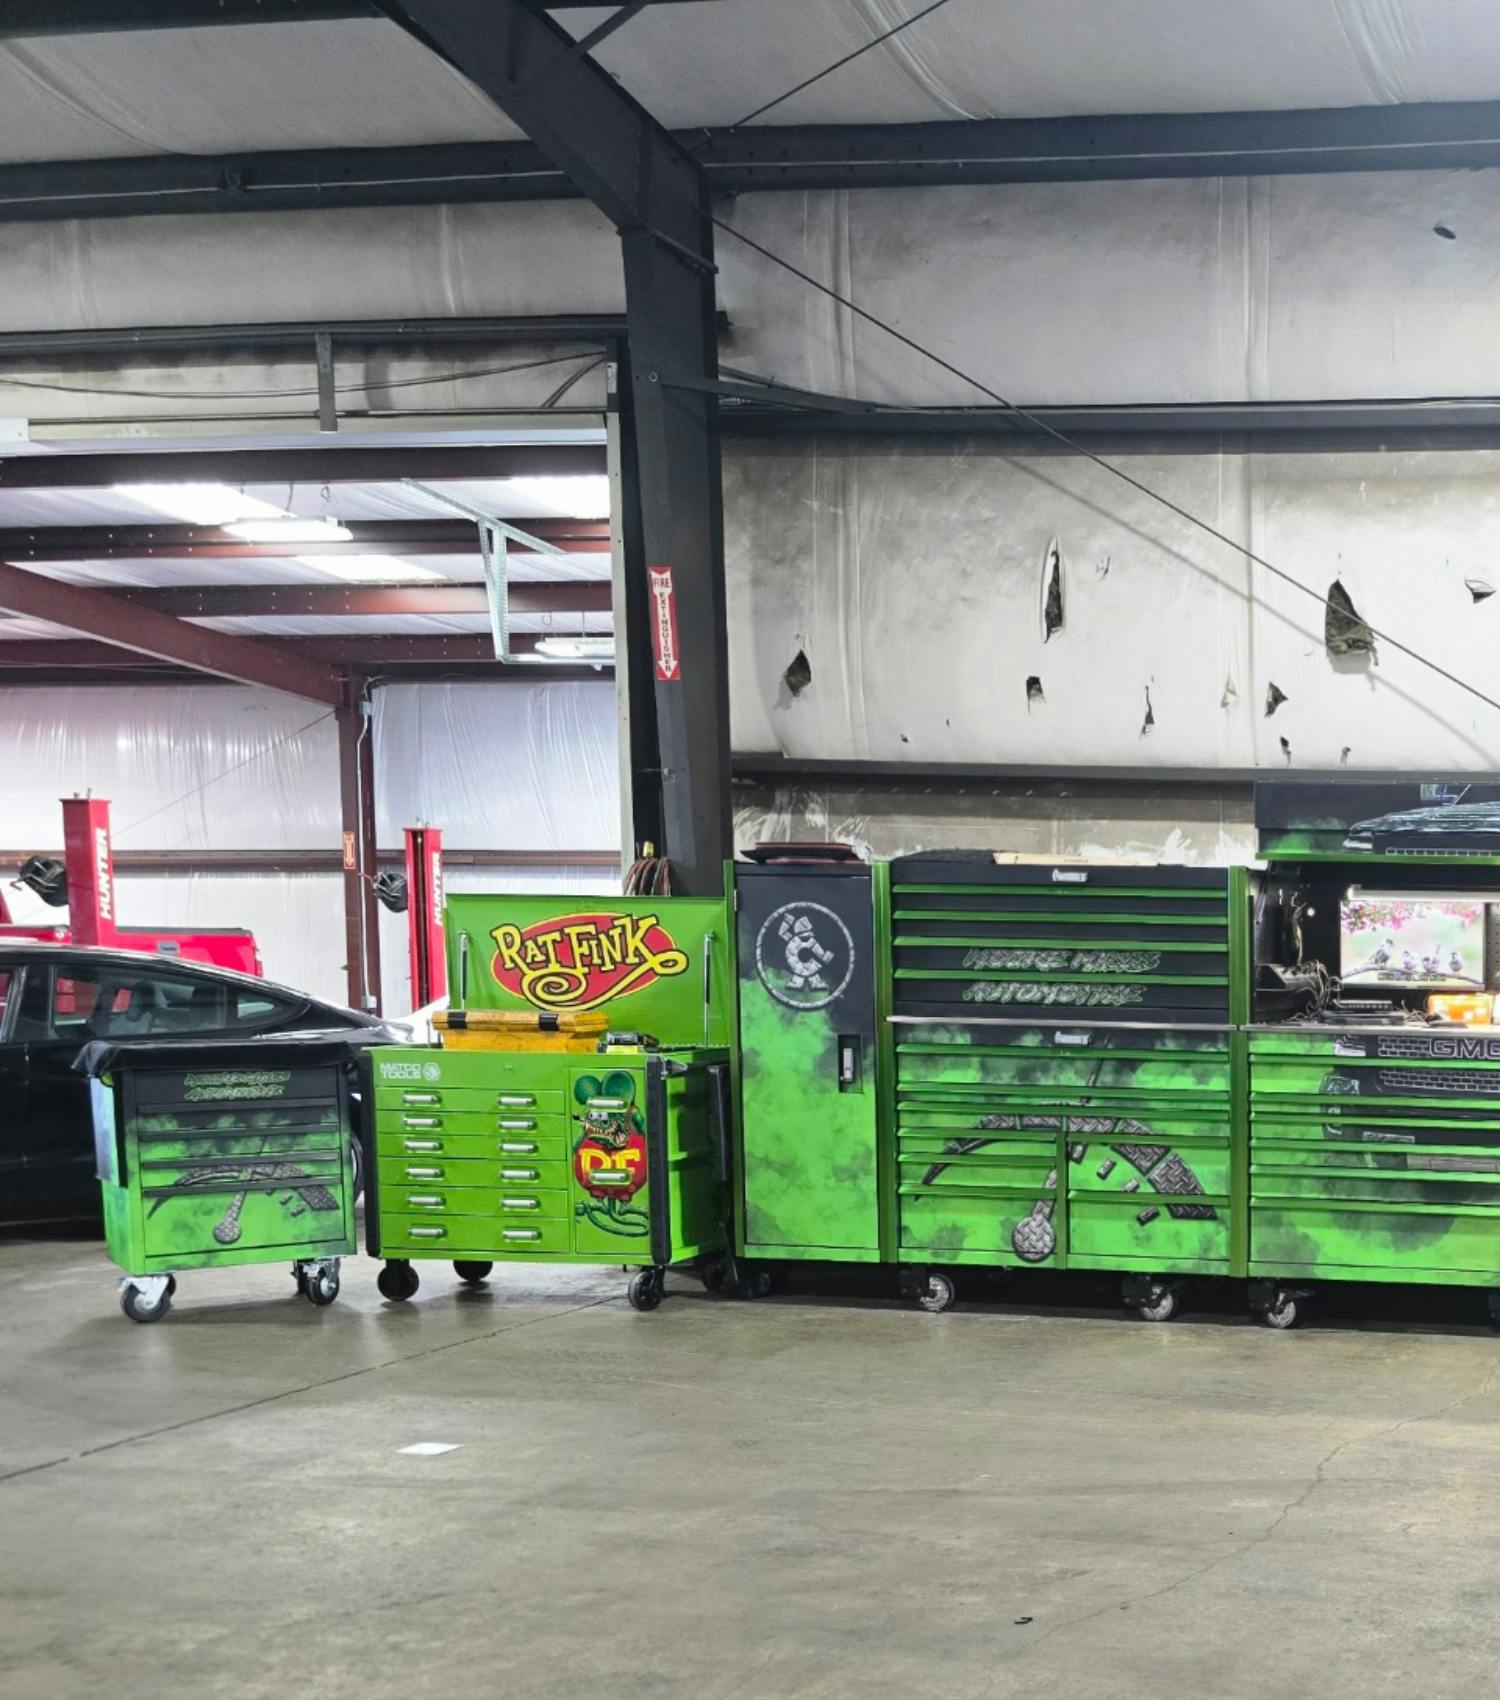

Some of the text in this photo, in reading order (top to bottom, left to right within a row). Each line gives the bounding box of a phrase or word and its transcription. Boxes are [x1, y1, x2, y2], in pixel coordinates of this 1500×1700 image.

[652, 578, 670, 588] FIRE
[660, 592, 672, 672] EXTINGUISHER
[96, 828, 111, 920] HUNTER
[431, 851, 443, 926] HUNTER
[380, 1062, 421, 1072] MATCO
[381, 1071, 421, 1080] TOOLS
